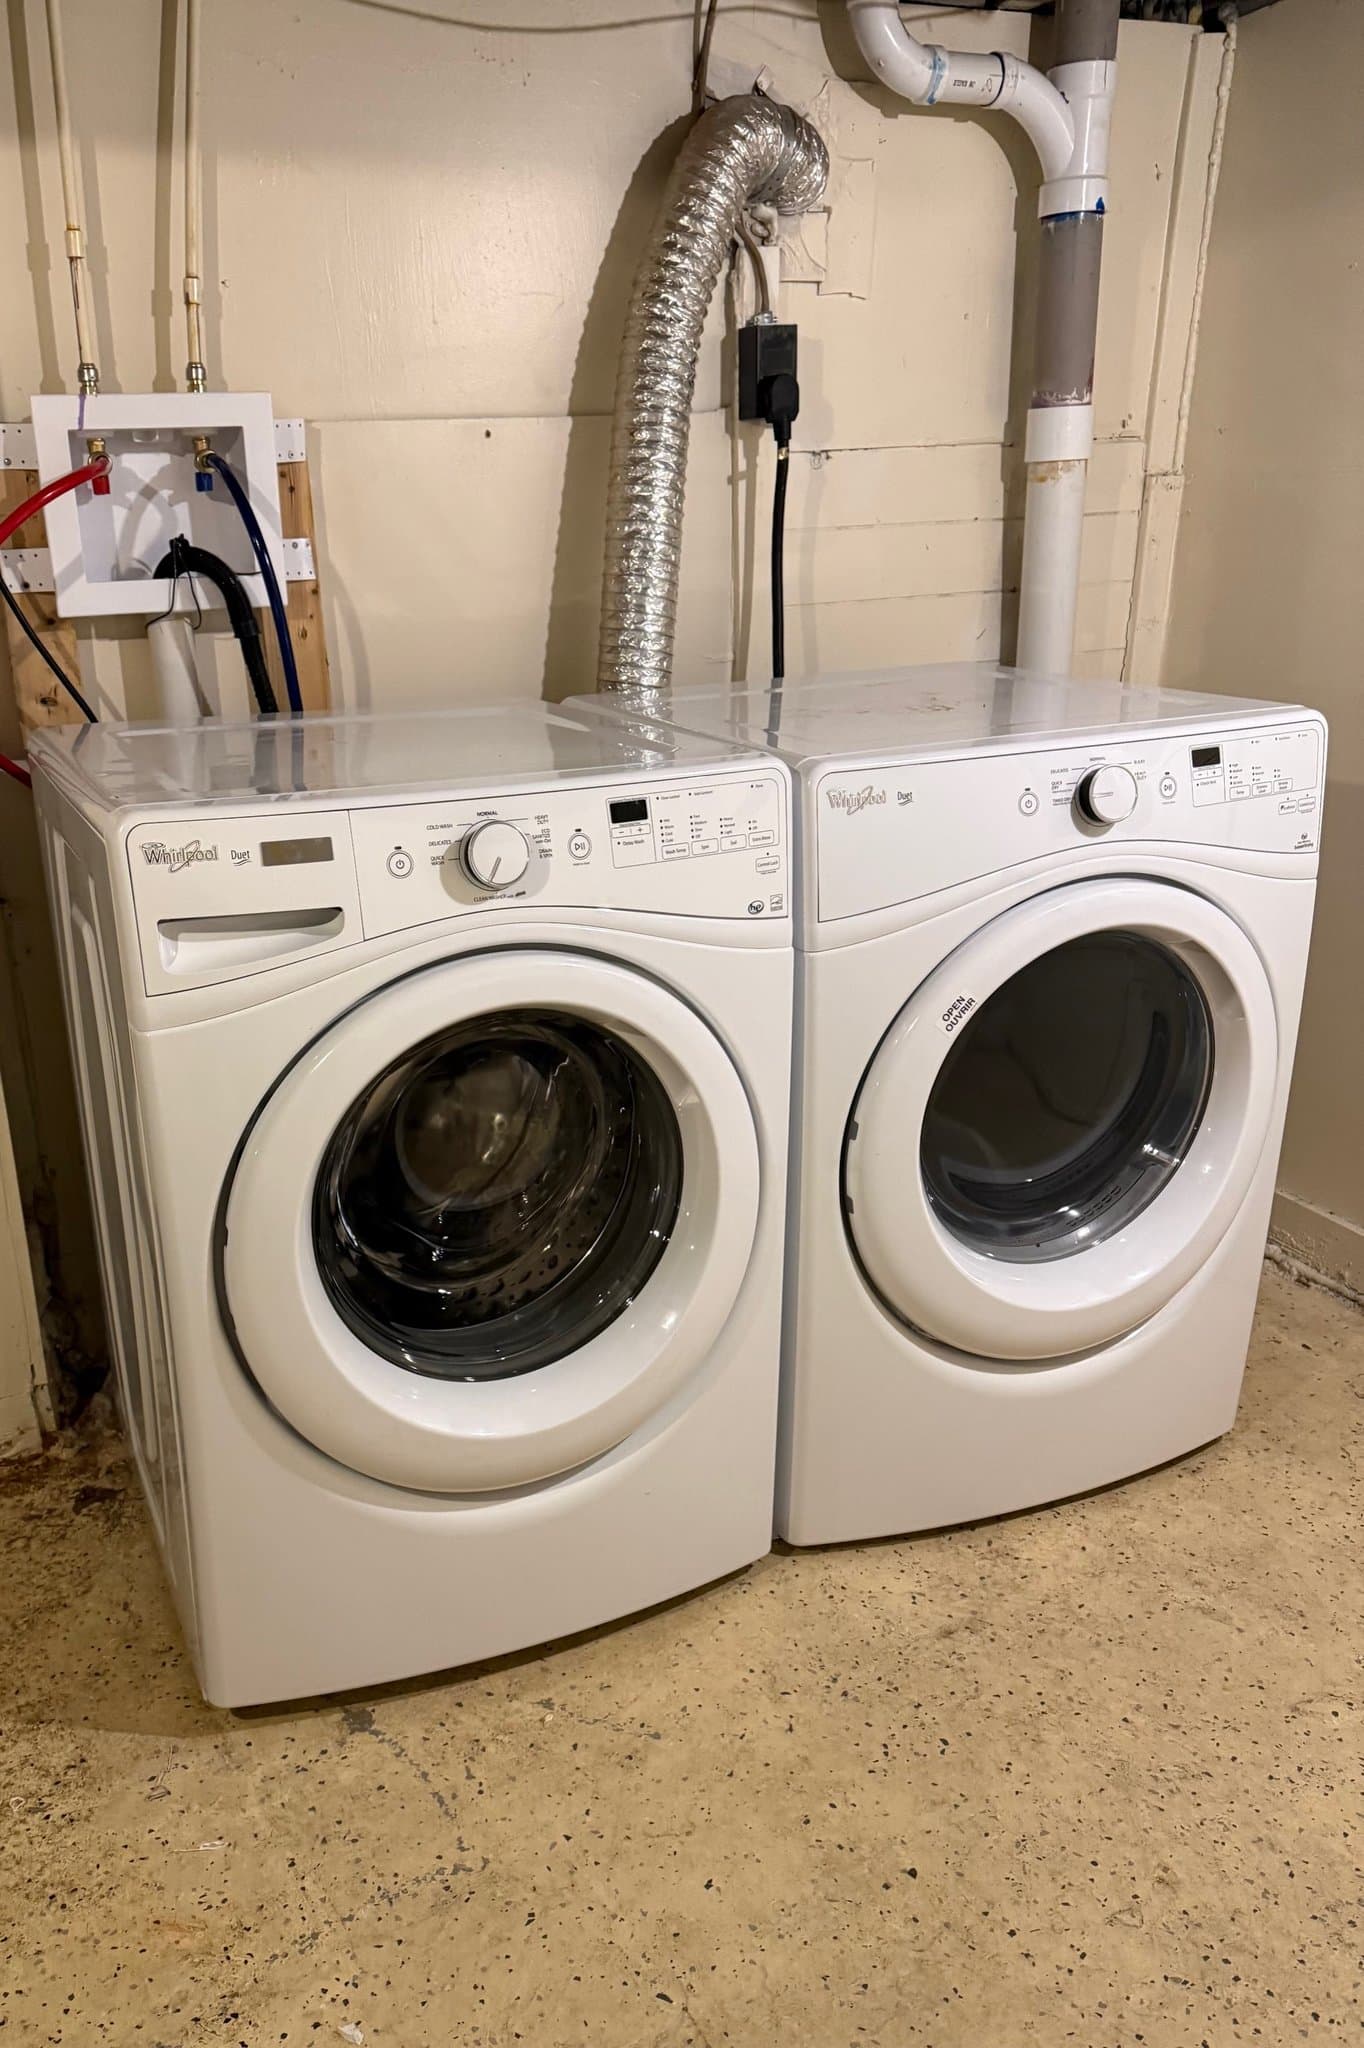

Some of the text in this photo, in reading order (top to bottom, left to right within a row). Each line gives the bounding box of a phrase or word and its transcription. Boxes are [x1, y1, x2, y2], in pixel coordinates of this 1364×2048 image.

[826, 787, 886, 812] Whirlpool
[142, 841, 251, 870] Whirlpool Duet
[942, 995, 965, 1022] OPEN
[945, 997, 976, 1032] OUVRIR
